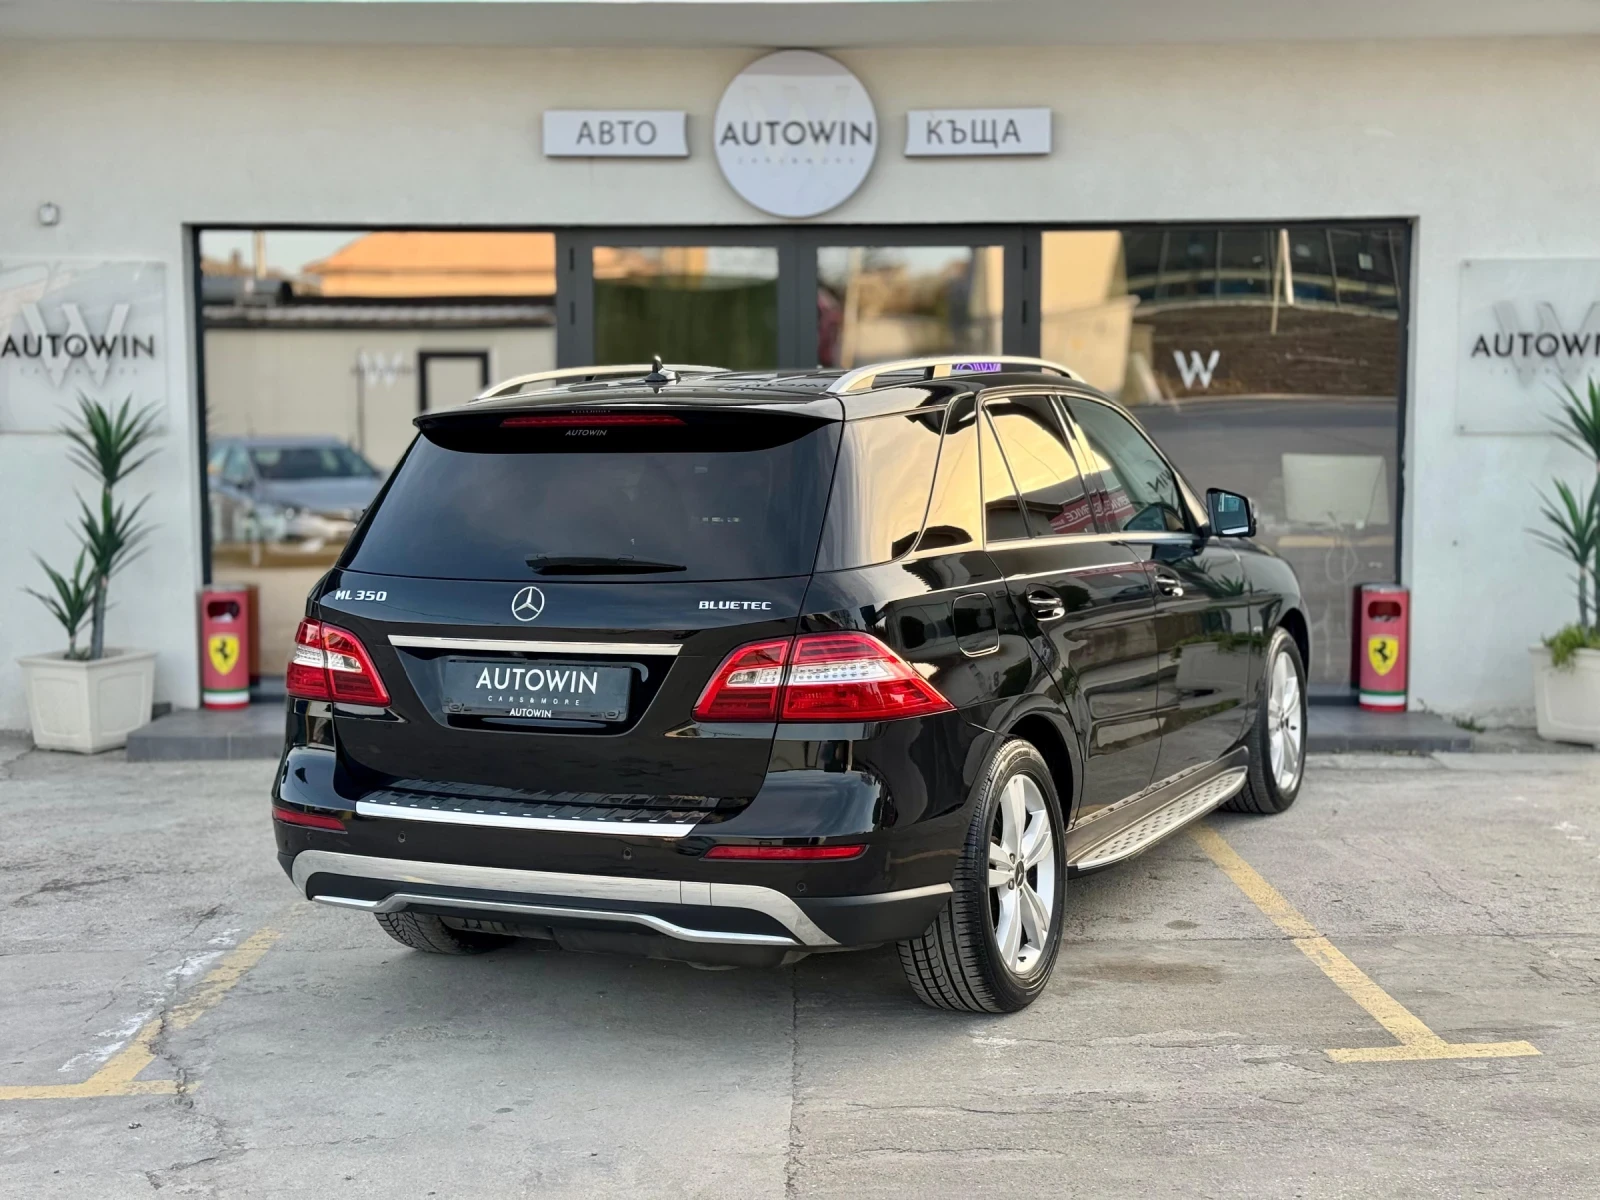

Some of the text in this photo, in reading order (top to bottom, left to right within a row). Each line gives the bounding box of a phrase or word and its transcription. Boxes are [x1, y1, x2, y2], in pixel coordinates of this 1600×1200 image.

[575, 120, 657, 145] АВТО
[719, 120, 873, 147] AUTOWIN
[925, 118, 1021, 148] КЪЩА
[0, 332, 155, 359] AUTOWIN
[1173, 349, 1220, 390] W
[565, 429, 608, 437] AUTOWIN
[335, 590, 388, 602] ML 350
[698, 600, 772, 610] BLUETEC
[475, 666, 599, 695] AUTOWIN
[509, 707, 552, 719] AUTOWIN
